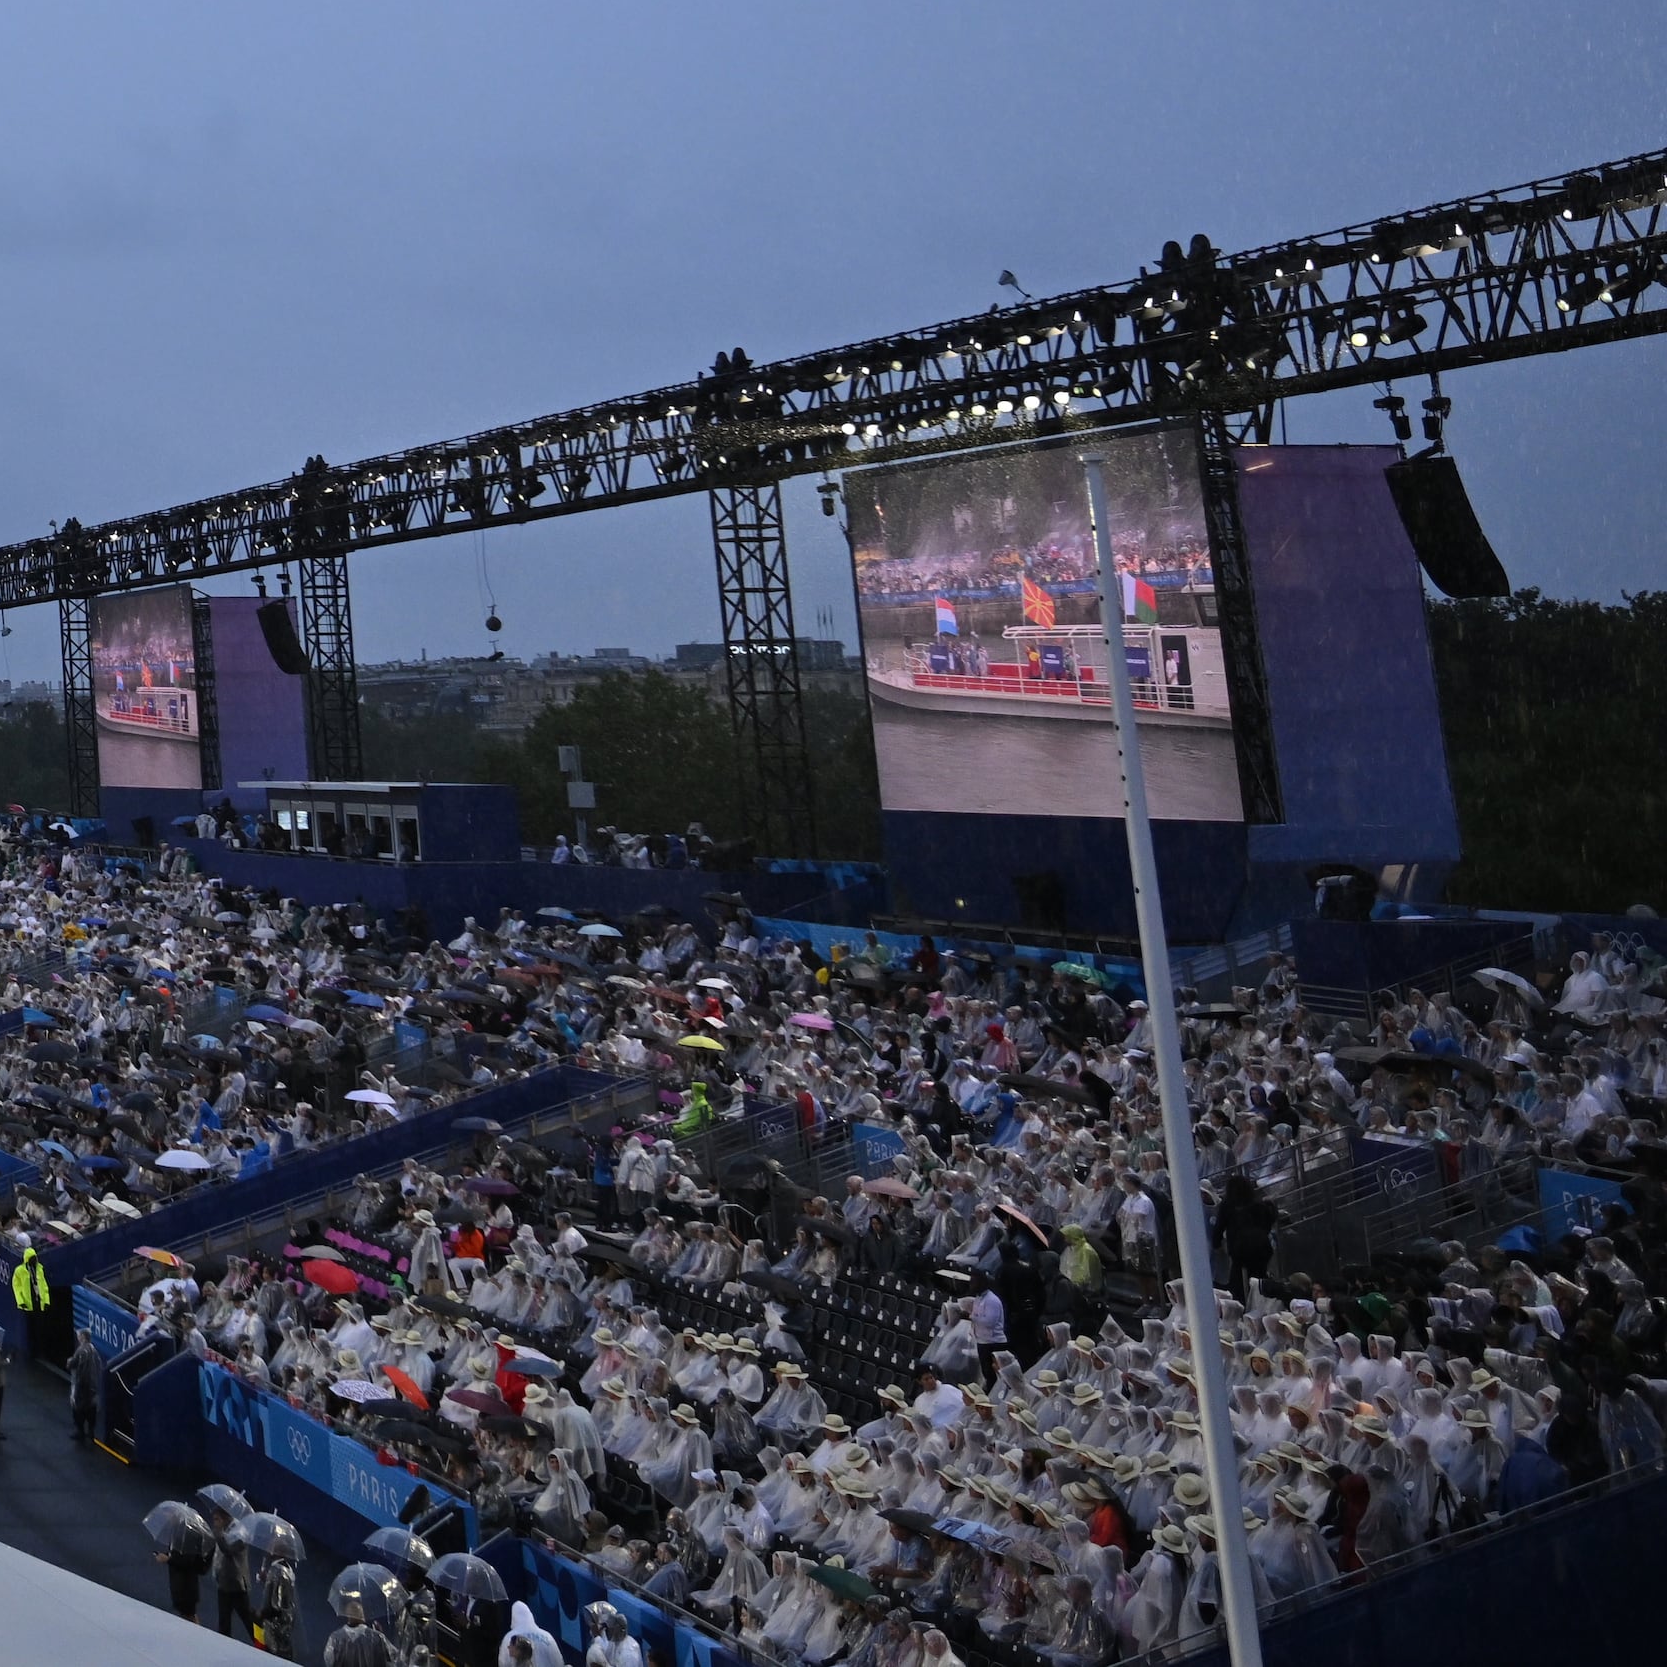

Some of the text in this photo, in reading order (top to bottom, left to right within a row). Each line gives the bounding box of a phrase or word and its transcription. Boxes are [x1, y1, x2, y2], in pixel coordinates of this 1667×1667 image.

[88, 1309, 135, 1352] PARIS 20
[348, 1462, 399, 1518] PARIS
